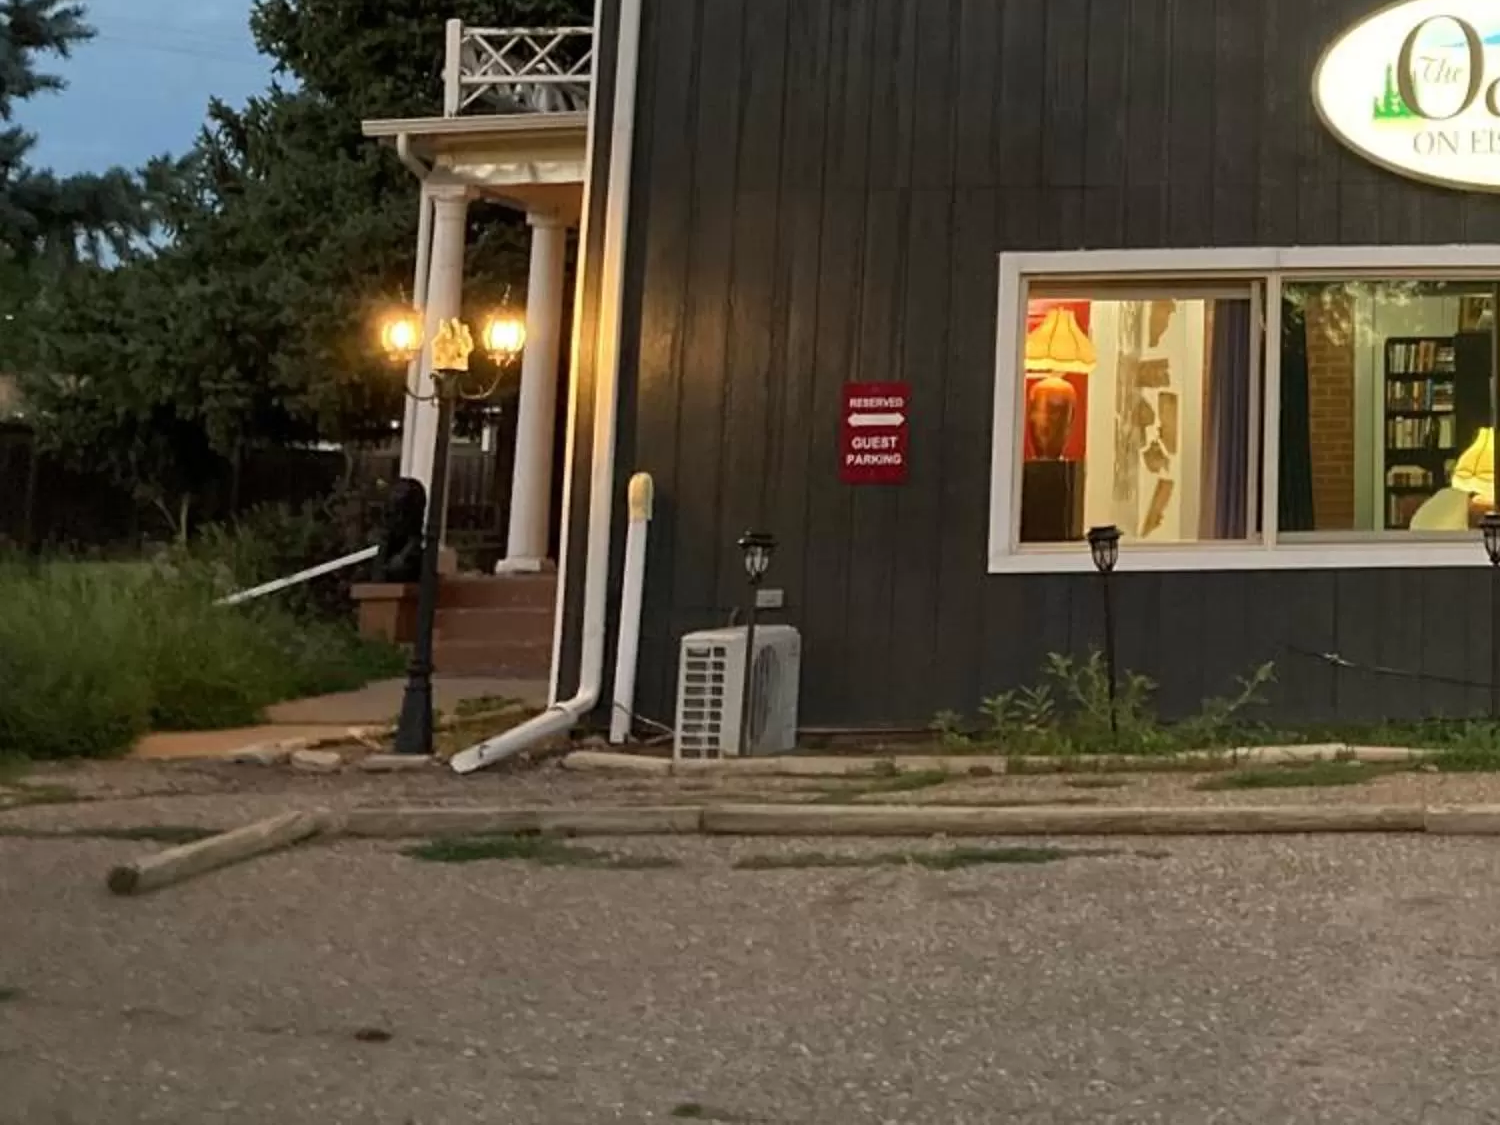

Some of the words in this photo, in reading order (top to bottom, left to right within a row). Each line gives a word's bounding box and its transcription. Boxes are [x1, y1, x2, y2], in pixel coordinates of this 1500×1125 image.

[1416, 55, 1464, 84] The
[1412, 129, 1460, 156] ON
[849, 397, 904, 408] RESERVED
[851, 436, 898, 450] GUEST
[846, 453, 902, 466] PARKING
